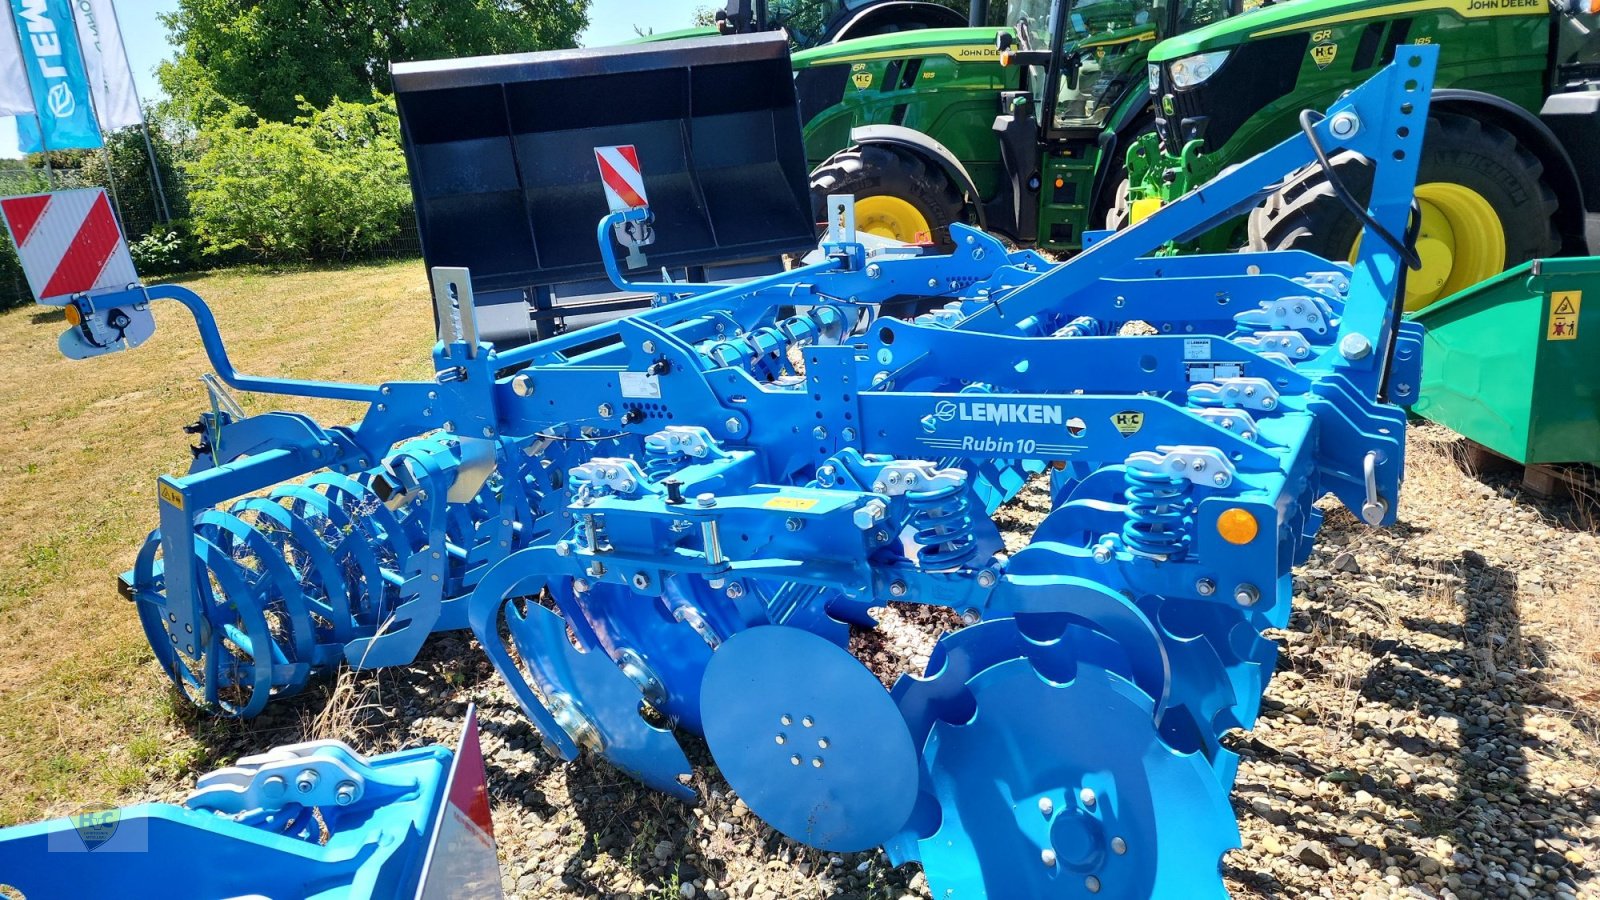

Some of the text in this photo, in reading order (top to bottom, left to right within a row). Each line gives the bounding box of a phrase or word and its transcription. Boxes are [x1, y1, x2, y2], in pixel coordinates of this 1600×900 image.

[1467, 0, 1539, 10] JOHN DEERE
[1312, 29, 1332, 42] 6R
[1414, 36, 1433, 46] 185
[852, 63, 866, 71] 6R
[959, 402, 1062, 426] LEMKEN
[961, 436, 1036, 454] Rubin 10
